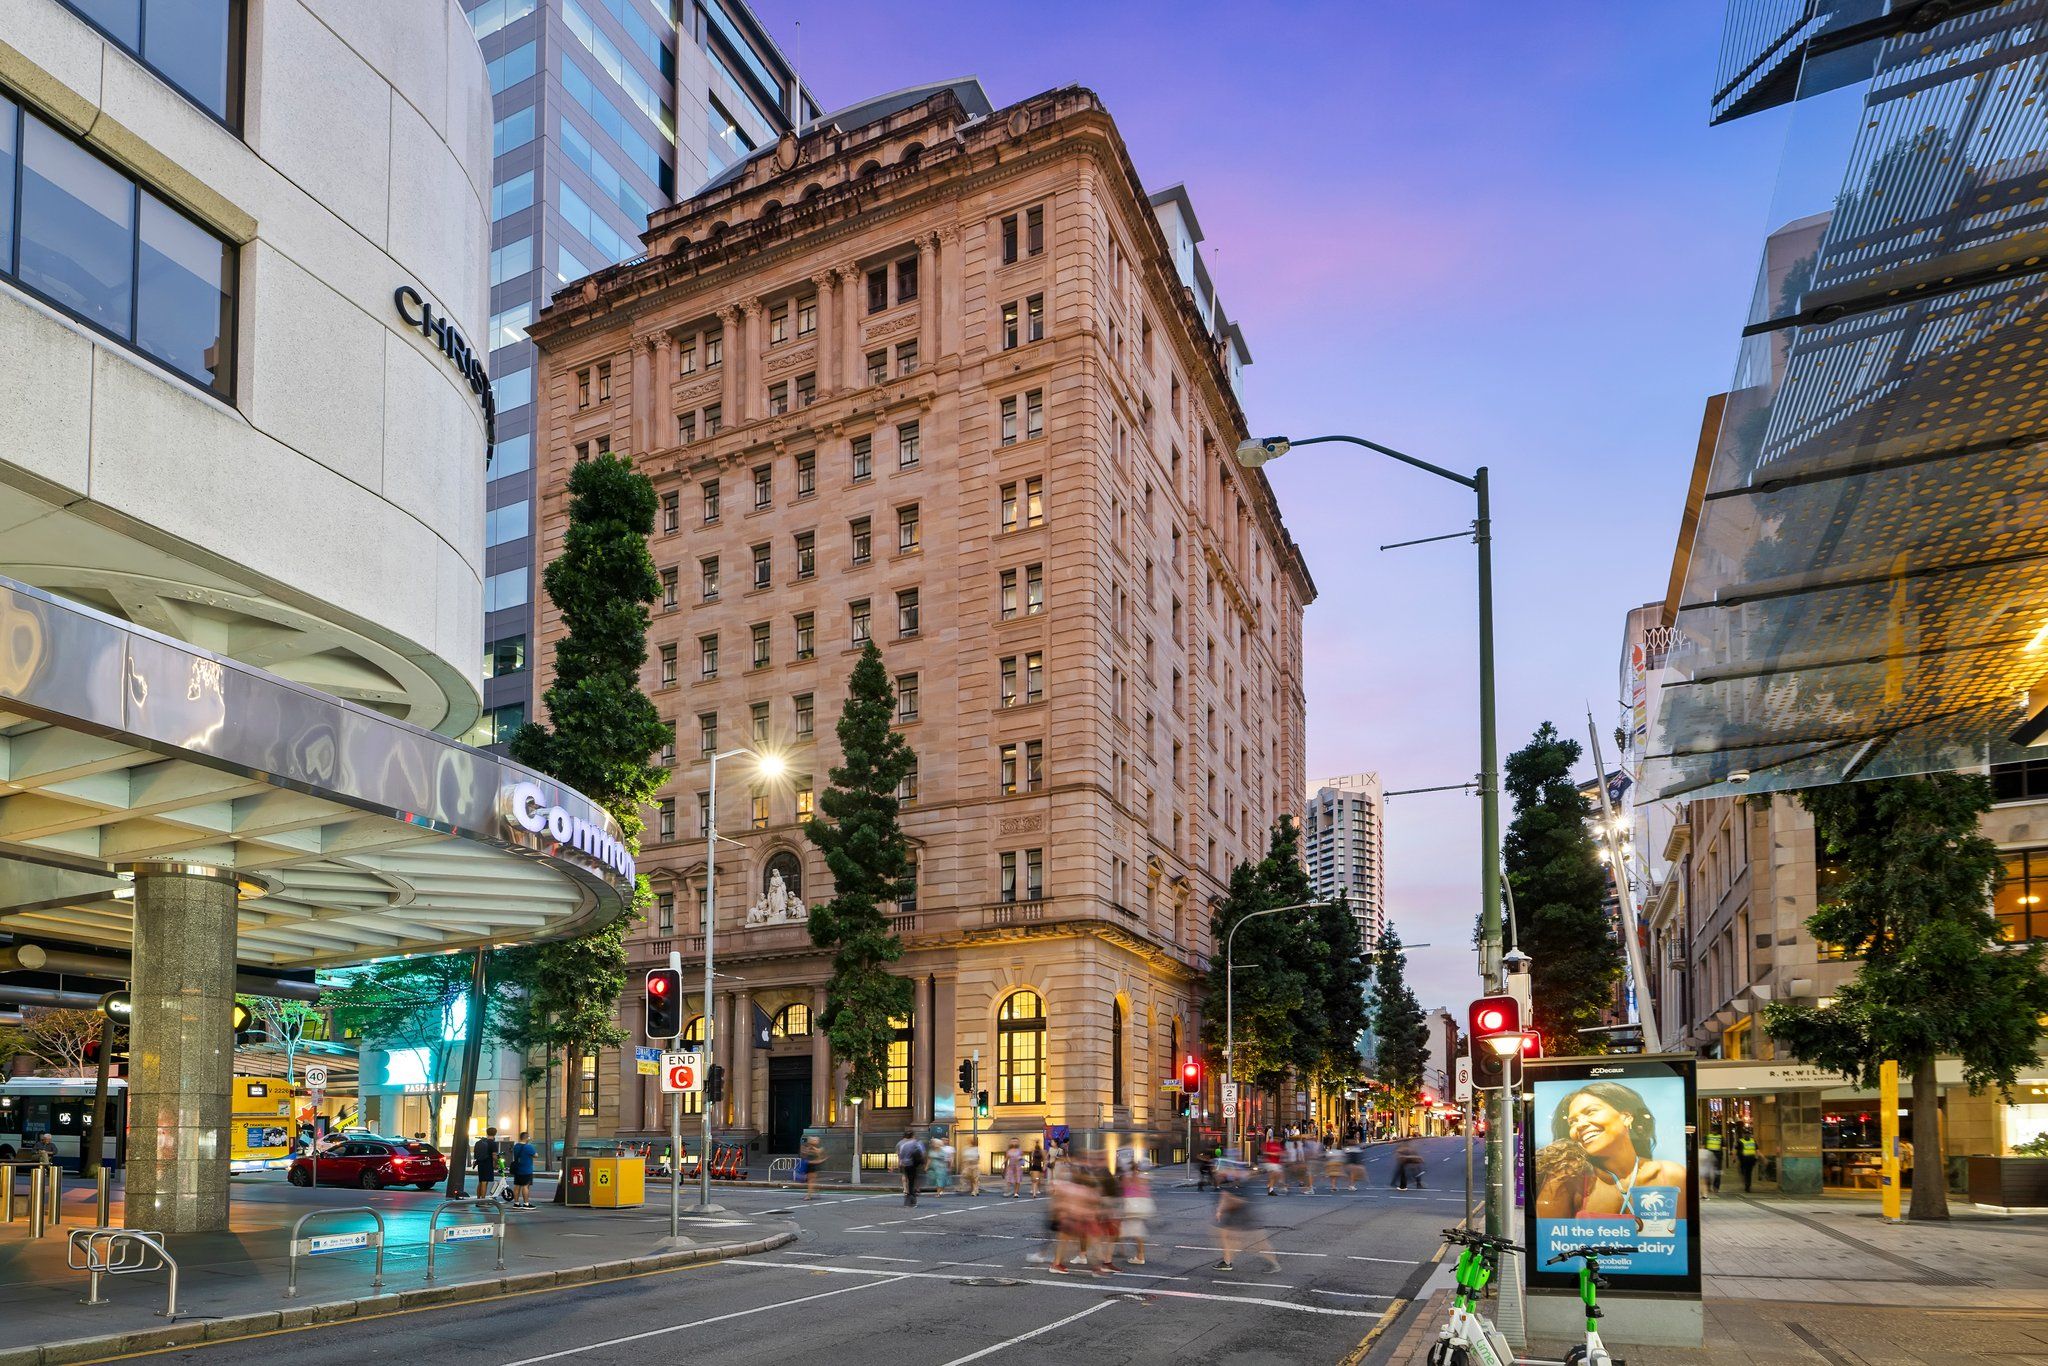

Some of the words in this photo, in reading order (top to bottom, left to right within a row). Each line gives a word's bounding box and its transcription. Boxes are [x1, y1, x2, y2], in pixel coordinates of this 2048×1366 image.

[669, 1056, 695, 1065] END
[308, 1072, 324, 1081] 40
[675, 1068, 688, 1087] C
[1551, 1226, 1568, 1237] All
[1571, 1226, 1594, 1237] the
[1597, 1226, 1631, 1237] feels
[1638, 1242, 1676, 1256] dairy
[1597, 1257, 1632, 1265] ocobella
[1476, 1339, 1495, 1366] Lime
